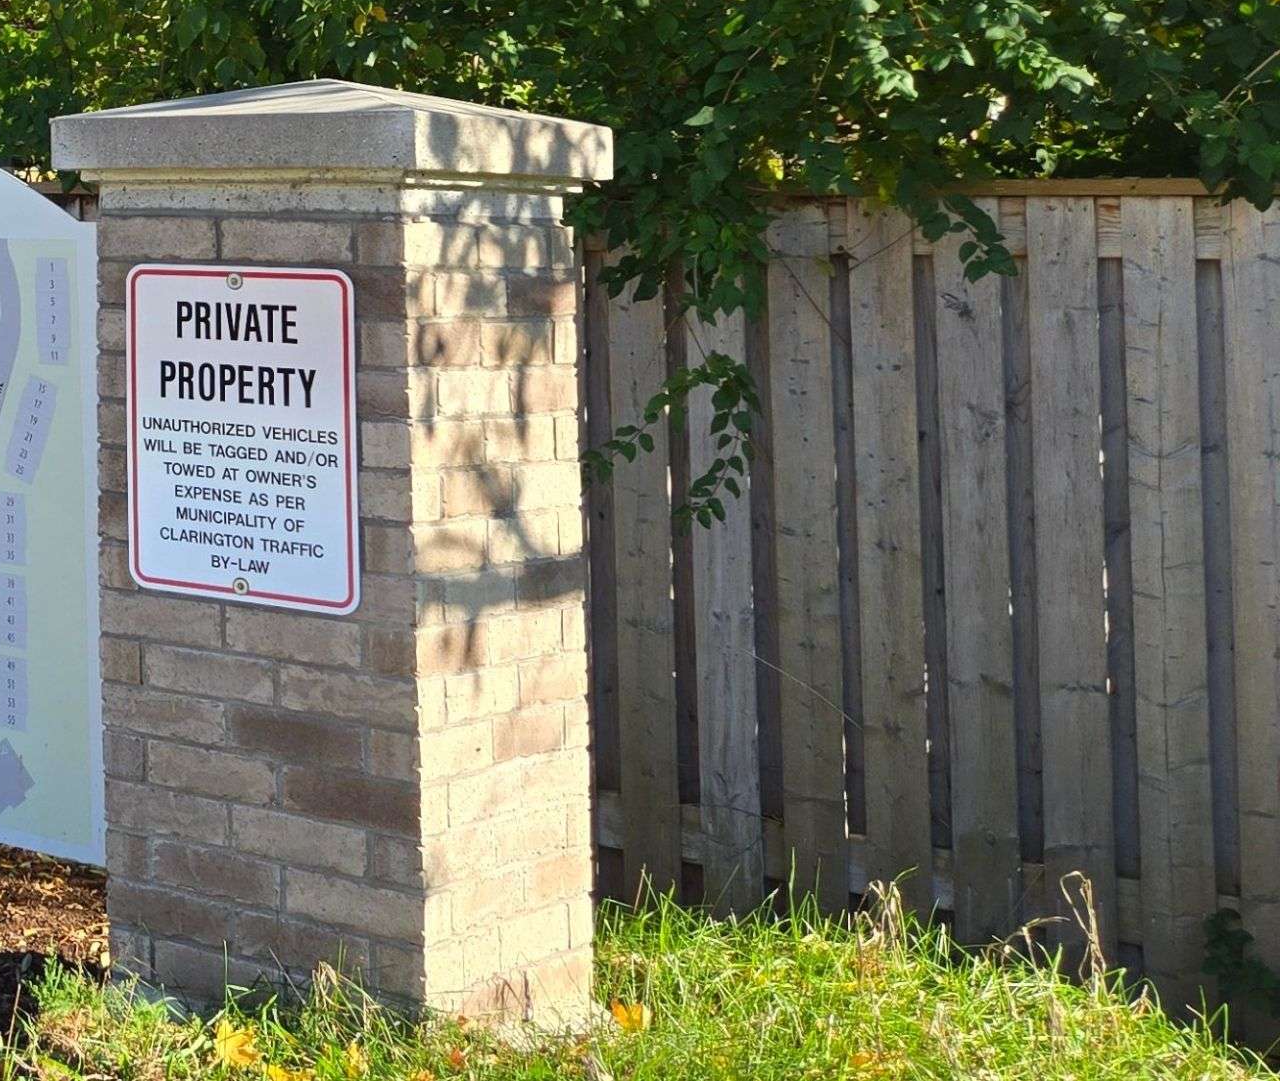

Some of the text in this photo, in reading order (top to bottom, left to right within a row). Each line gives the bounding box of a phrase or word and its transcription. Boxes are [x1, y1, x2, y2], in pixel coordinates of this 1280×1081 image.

[176, 301, 298, 345] PRIVATE
[160, 360, 317, 408] PROPERTY
[143, 417, 338, 445] UNAUTHORIZED VEHICLES
[143, 438, 339, 468] WILL BE TAGGED AND/OR
[163, 462, 317, 489] TOWED AT OWNER'S
[175, 485, 305, 510] EXPENSE AS PER
[176, 506, 305, 532] MUNICIPALITY OF
[160, 527, 324, 558] CLARINGTON TRAFFIC
[211, 555, 270, 574] BY-LAW
